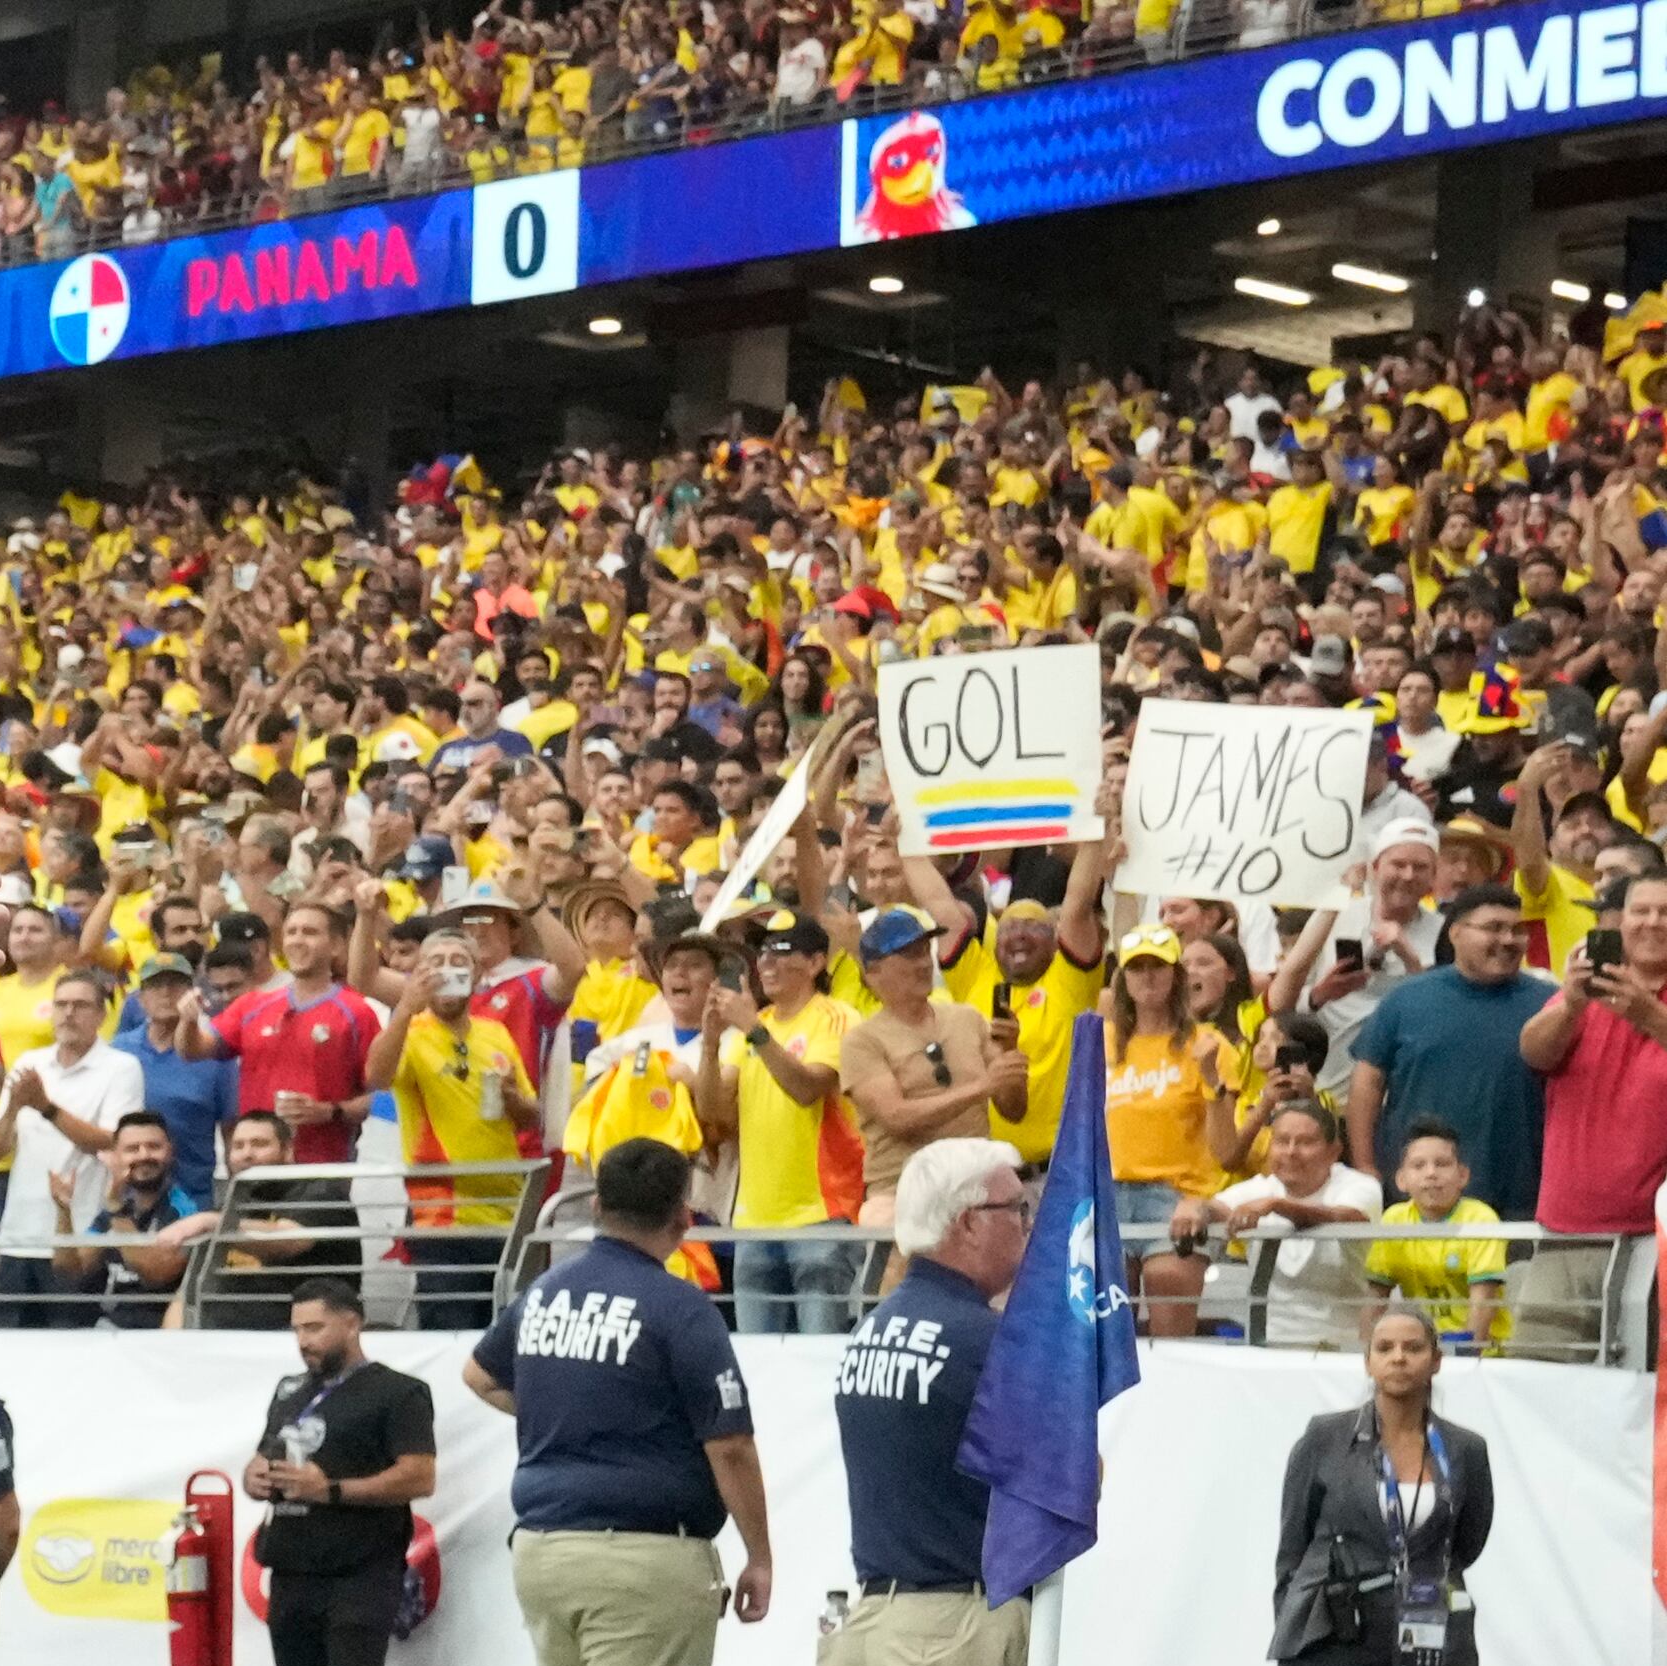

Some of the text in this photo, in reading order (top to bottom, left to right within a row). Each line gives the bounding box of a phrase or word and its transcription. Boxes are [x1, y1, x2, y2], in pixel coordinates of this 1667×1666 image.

[185, 201, 548, 317] PANAMA 0
[898, 665, 1066, 777] GOL
[1138, 724, 1363, 859] JAMES
[1163, 834, 1283, 895] #10
[517, 1317, 642, 1367] SECURITY
